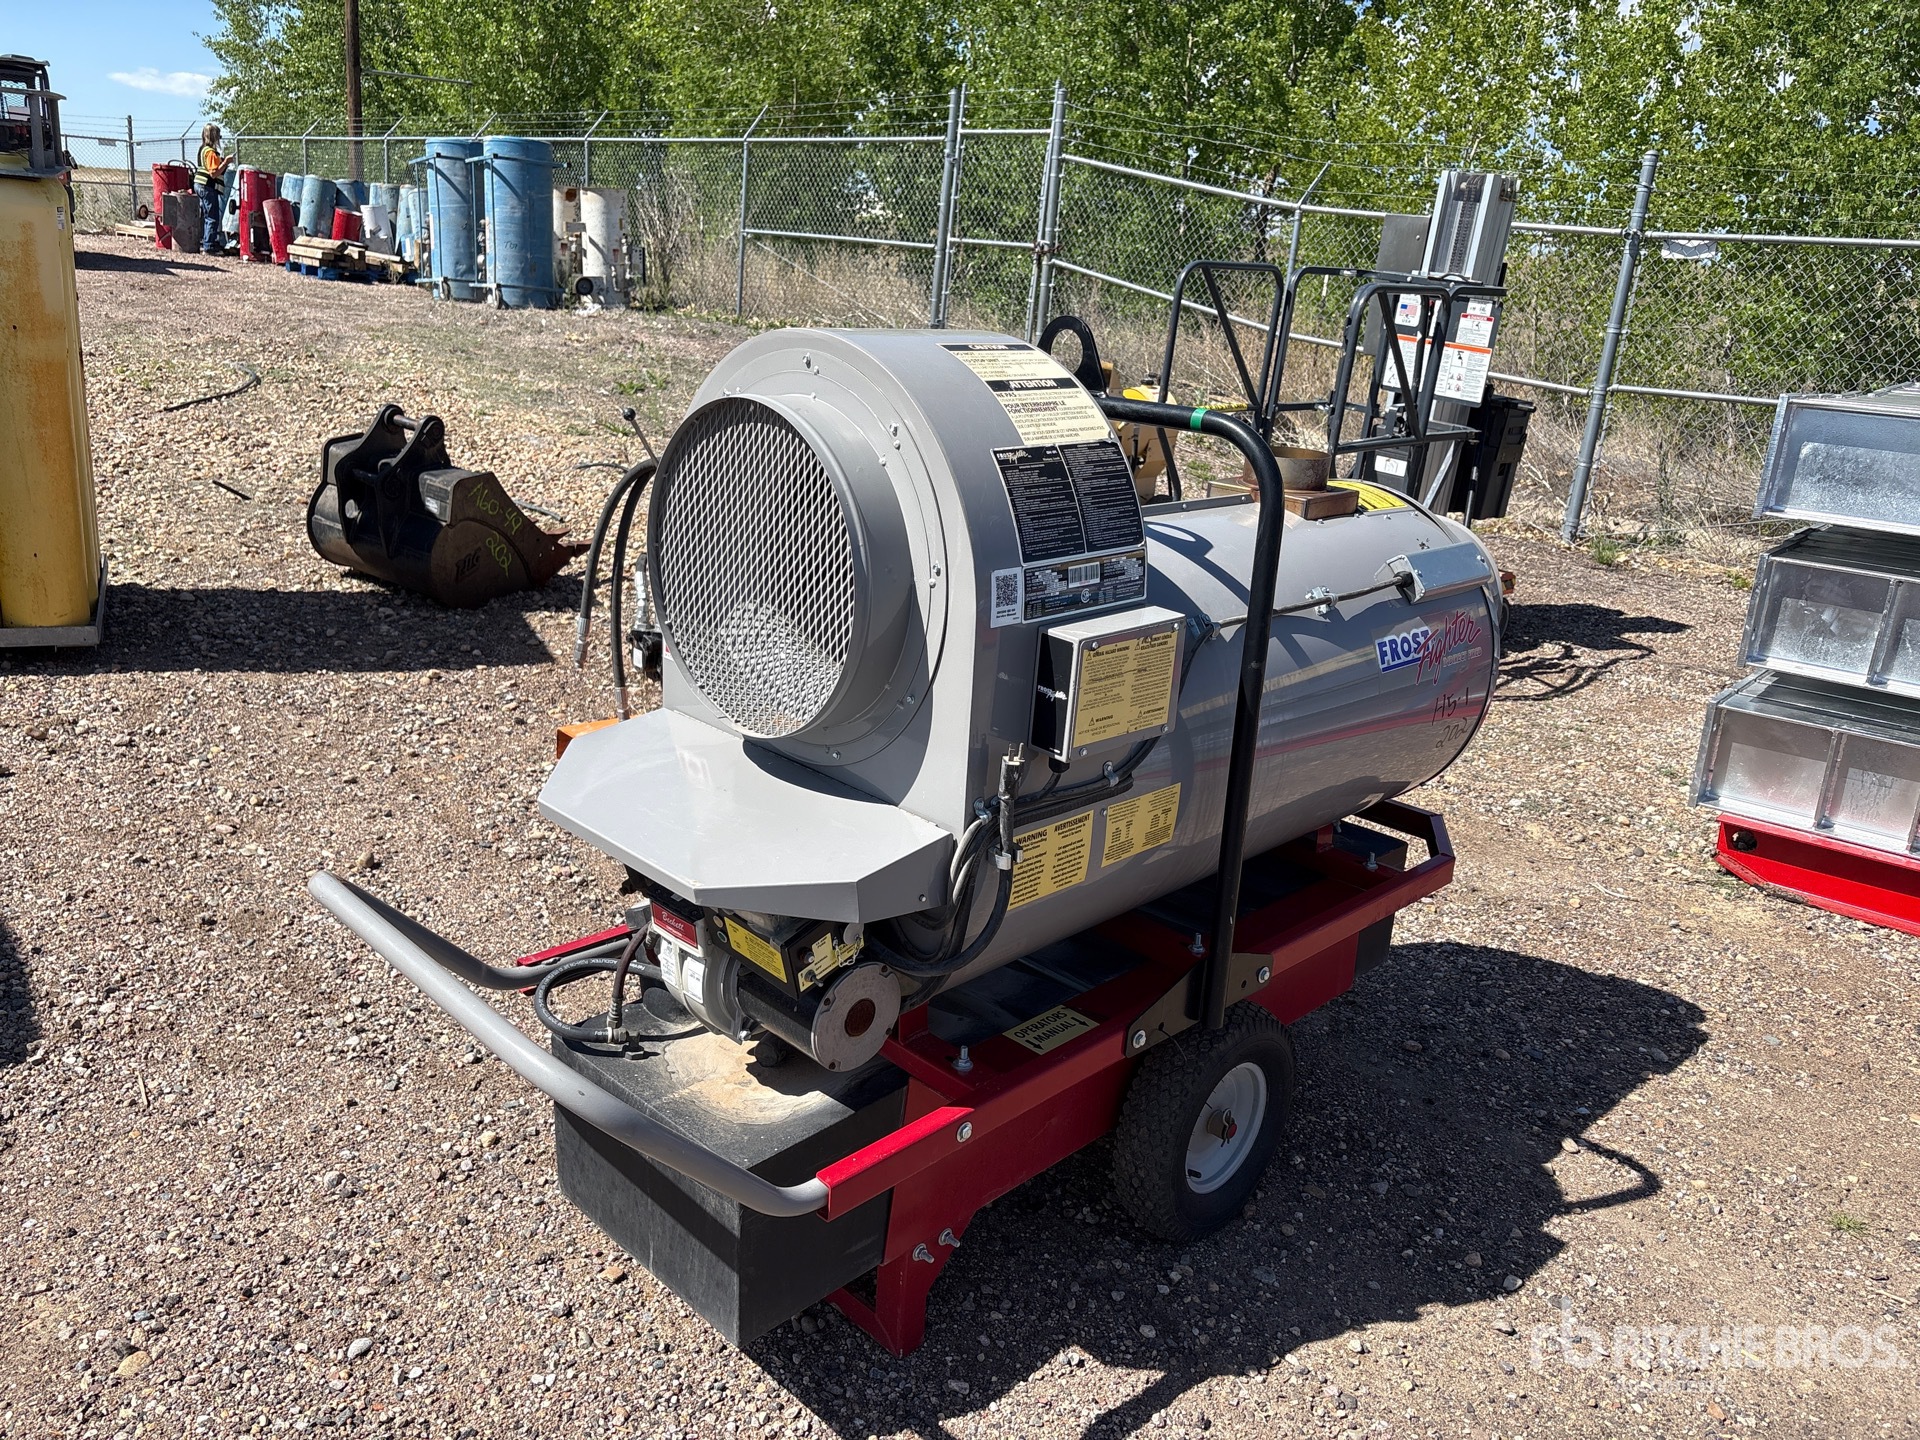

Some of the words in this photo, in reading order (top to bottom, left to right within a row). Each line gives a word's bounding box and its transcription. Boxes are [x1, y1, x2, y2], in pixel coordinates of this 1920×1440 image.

[1008, 379, 1058, 389] ATTENTION
[1377, 629, 1430, 666] FROST
[1416, 610, 1482, 686] Fighter
[1054, 813, 1090, 833] AVERTISSEMENT
[1016, 829, 1047, 845] WARNING
[662, 911, 684, 931] Beckett
[1033, 1020, 1077, 1044] MANUAL
